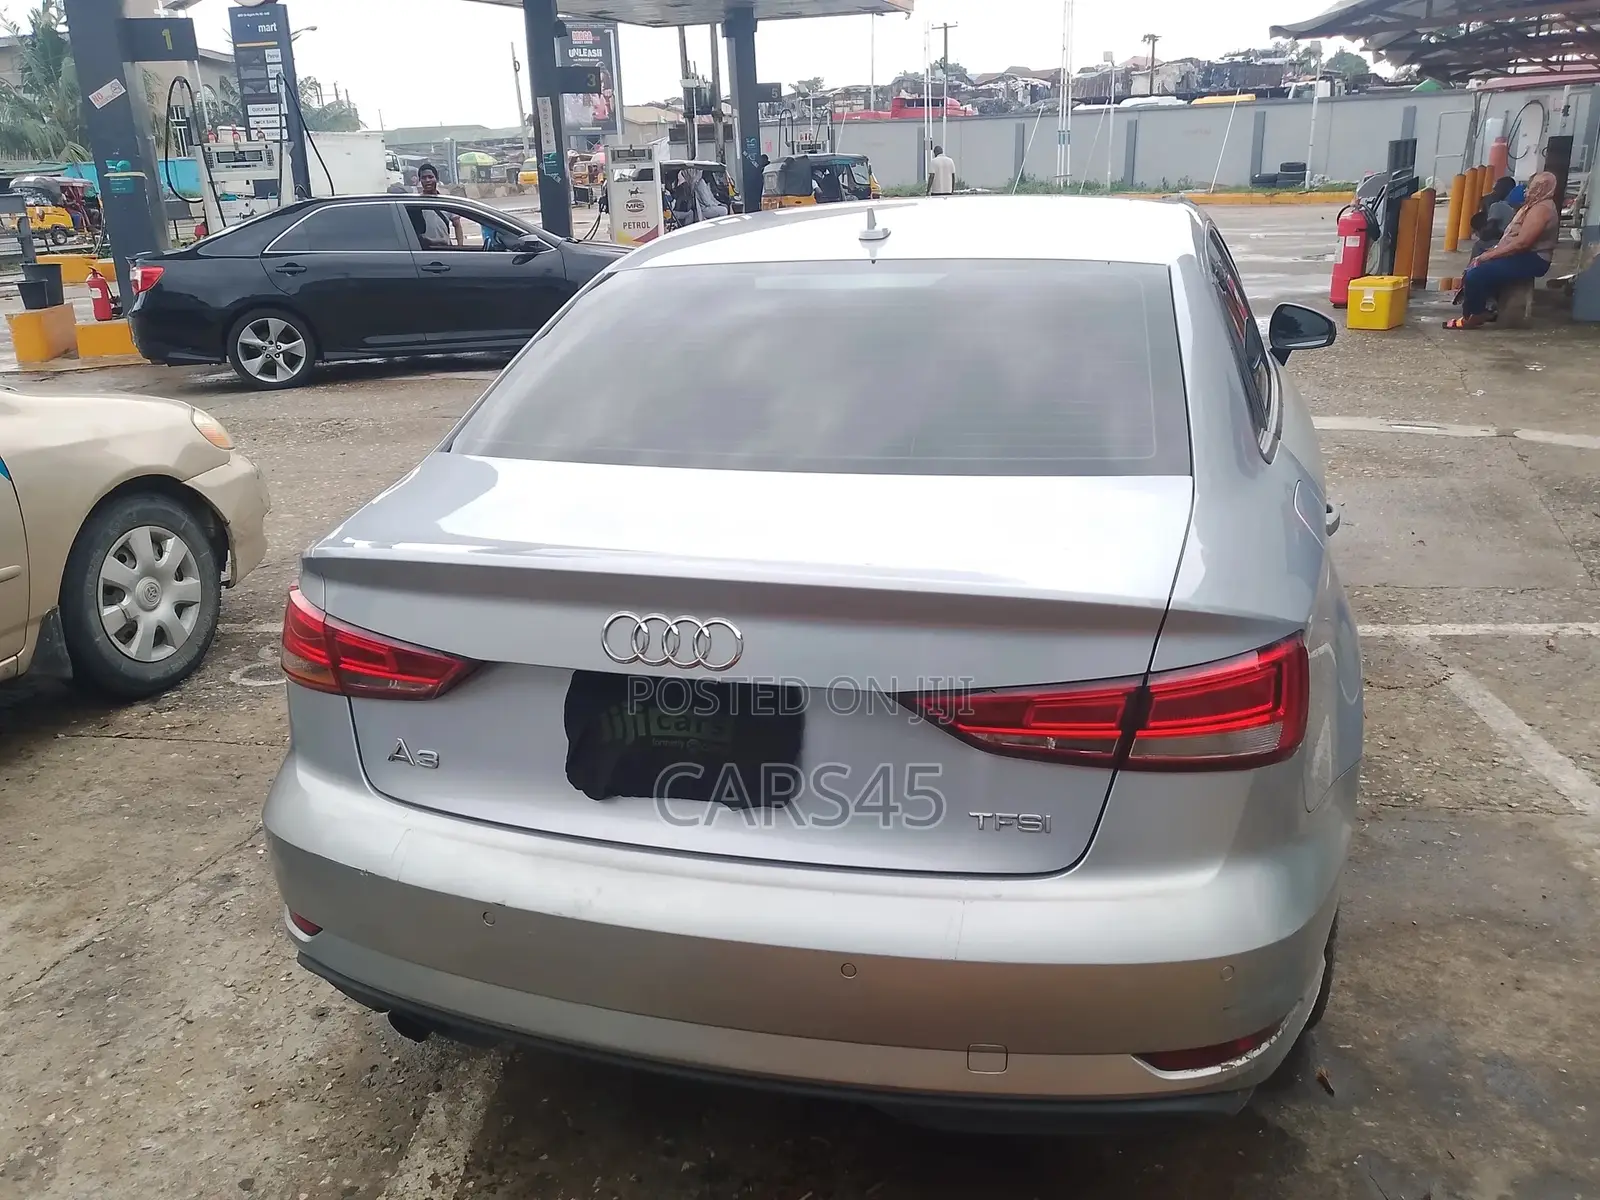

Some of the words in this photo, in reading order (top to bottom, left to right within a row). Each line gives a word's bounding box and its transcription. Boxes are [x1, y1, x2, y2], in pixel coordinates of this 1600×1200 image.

[258, 22, 277, 32] mart
[161, 28, 173, 50] 1
[568, 47, 603, 58] UNLEASH
[586, 73, 596, 87] 3
[771, 87, 779, 99] 5
[622, 221, 651, 230] PETROL
[387, 737, 440, 769] A3
[968, 811, 1052, 834] TFSI
